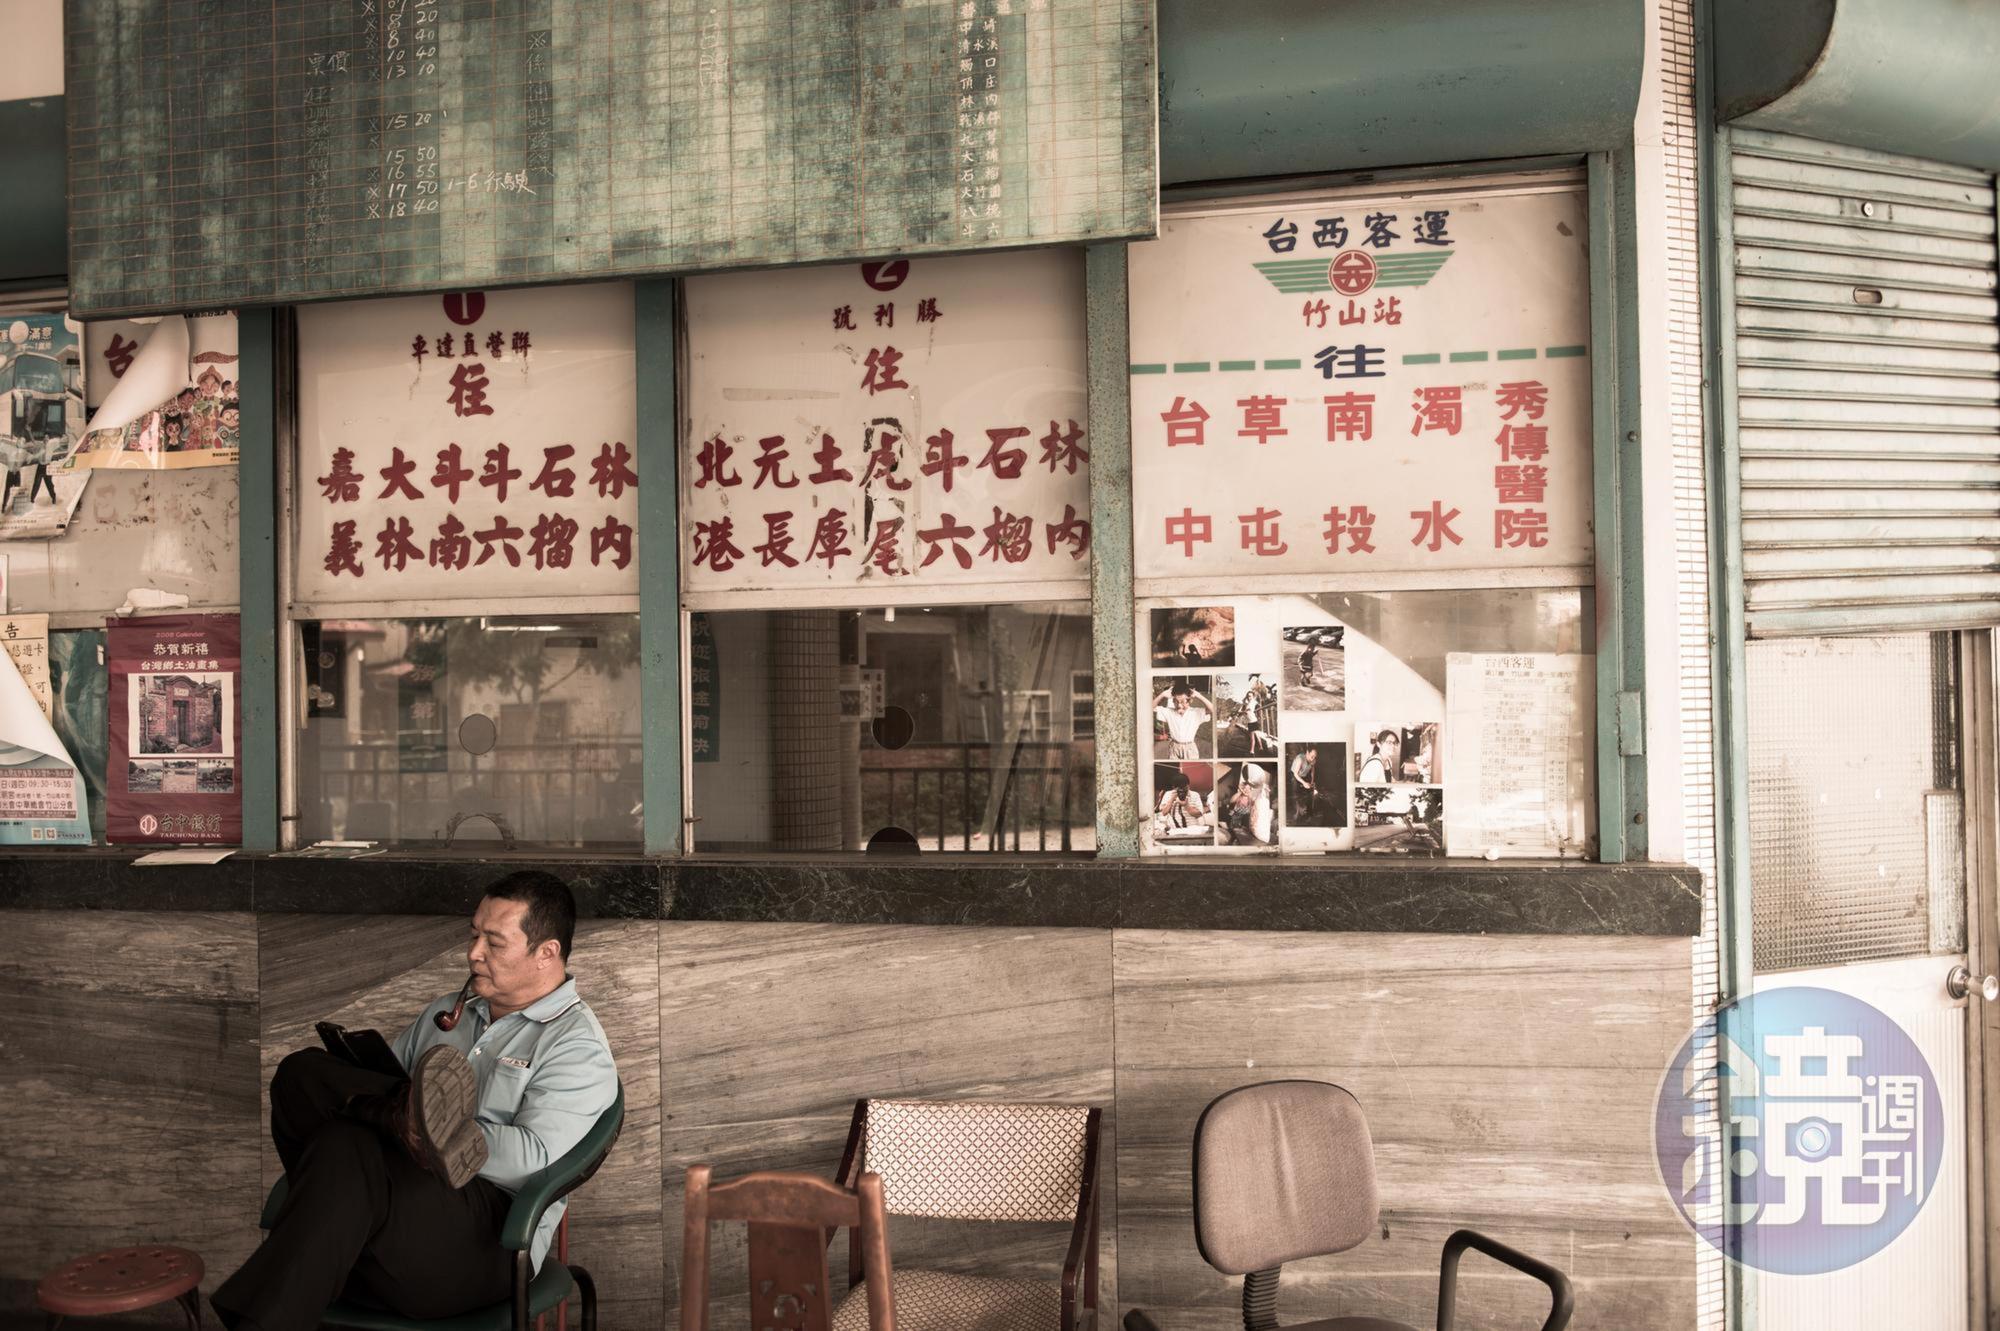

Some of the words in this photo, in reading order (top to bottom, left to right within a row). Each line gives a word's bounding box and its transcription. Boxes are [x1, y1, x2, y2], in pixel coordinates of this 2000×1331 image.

[415, 29, 435, 40] 40
[387, 50, 405, 62] 10
[416, 46, 436, 60] 40
[387, 65, 406, 79] 13
[419, 63, 435, 75] 10
[386, 114, 407, 130] 15
[386, 150, 407, 165] 15
[416, 147, 436, 162] 50
[387, 163, 405, 181] 16
[416, 163, 438, 178] 55
[388, 183, 407, 199] 17
[416, 180, 438, 196] 50
[389, 202, 406, 219] 18
[413, 199, 439, 213] 40
[1262, 209, 1456, 254] 台西客運
[1301, 296, 1403, 329] 竹山站
[860, 345, 909, 397] 往
[1313, 344, 1387, 379] 往
[1322, 391, 1376, 555] 南投
[1409, 385, 1464, 552] 濁水
[1493, 380, 1549, 550] 秀傳醫院
[1160, 396, 1213, 559] 台中
[1236, 395, 1289, 557] 草屯
[5, 622, 19, 639] 告
[153, 643, 209, 656] 恭賀新禧
[160, 813, 223, 832] 台中銀行
